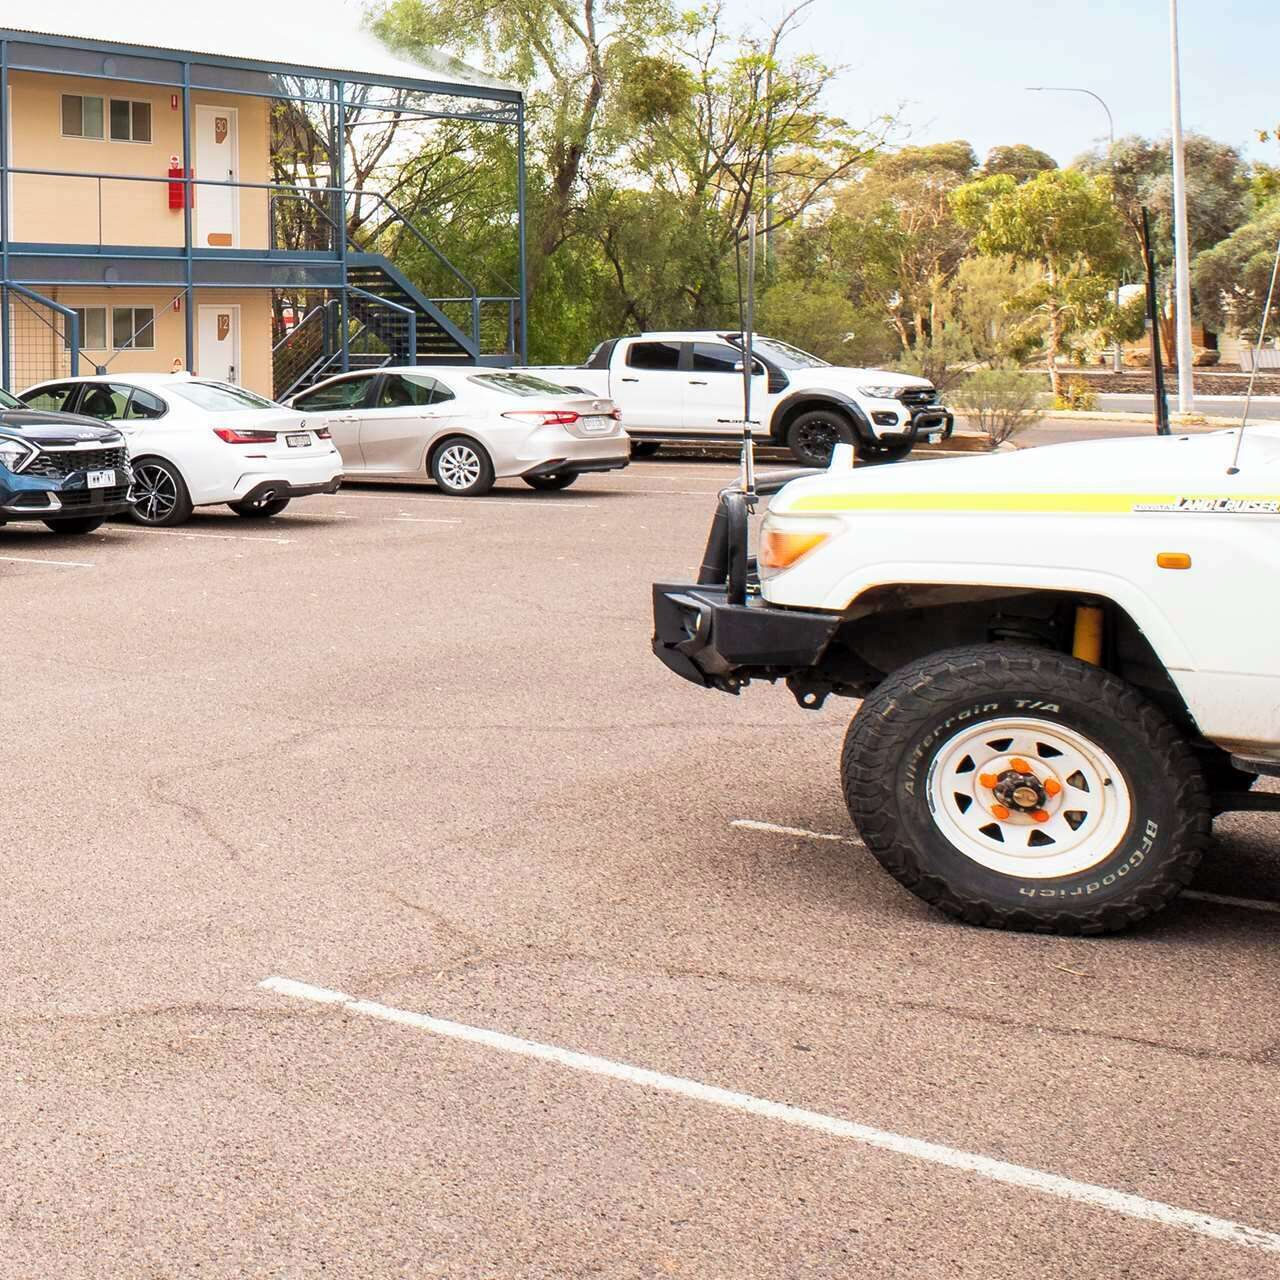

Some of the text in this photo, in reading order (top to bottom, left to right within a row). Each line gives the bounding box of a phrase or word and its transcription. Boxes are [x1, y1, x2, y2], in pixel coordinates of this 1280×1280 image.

[218, 315, 229, 330] 12
[1014, 699, 1062, 713] T/A
[1018, 819, 1159, 898] BFGoodrich
